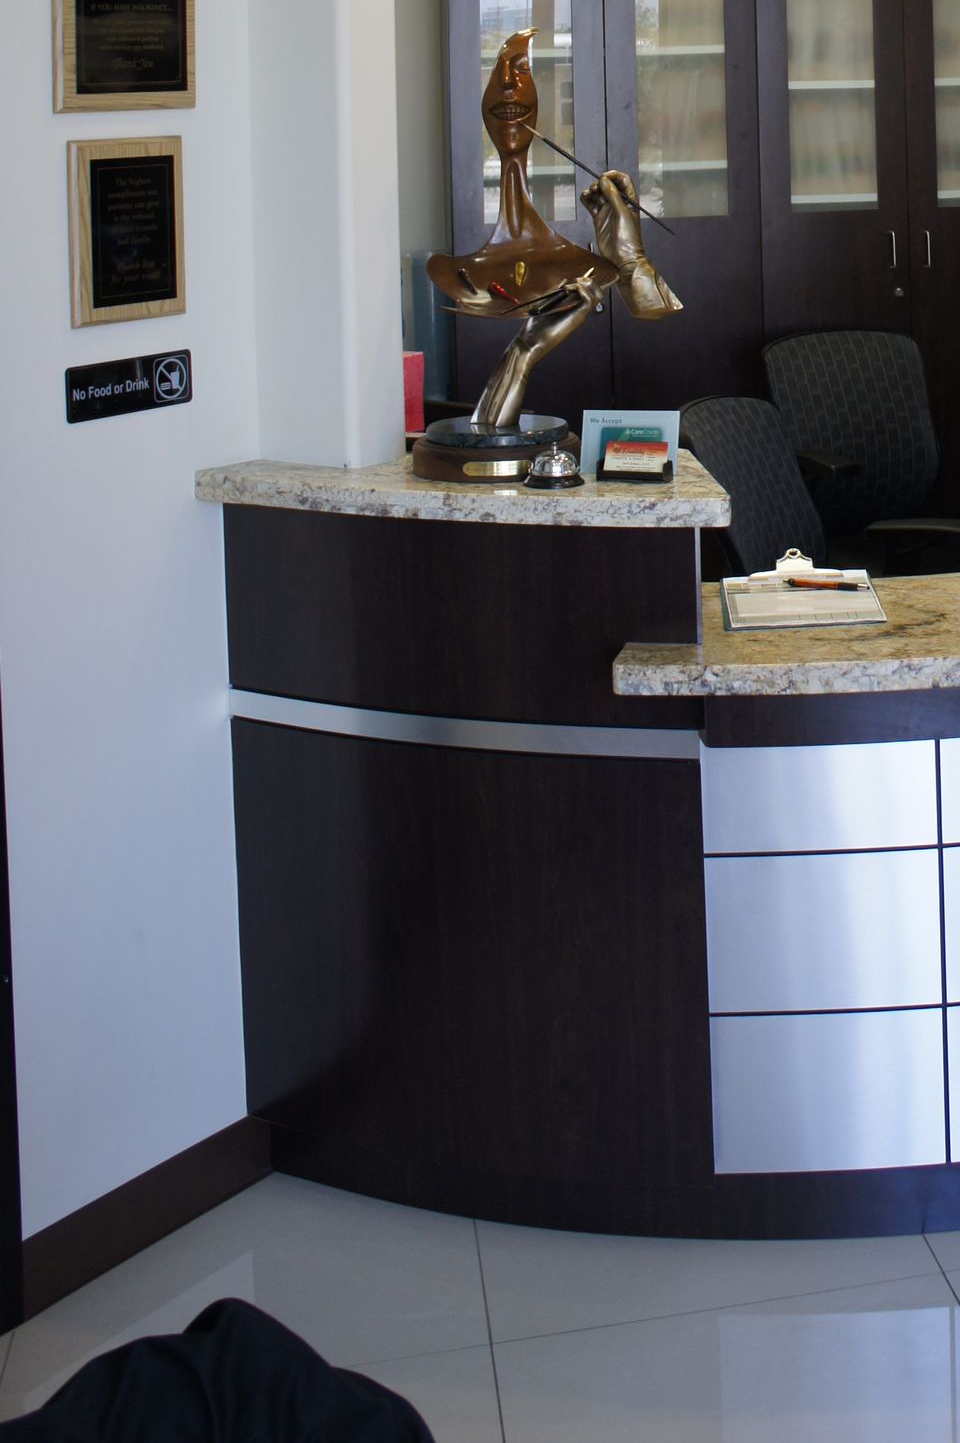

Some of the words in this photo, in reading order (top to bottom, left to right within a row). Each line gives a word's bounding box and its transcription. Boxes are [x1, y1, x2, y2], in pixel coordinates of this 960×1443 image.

[73, 388, 86, 402] No
[88, 383, 112, 399] Food
[114, 384, 123, 394] or
[126, 377, 150, 392] Drink
